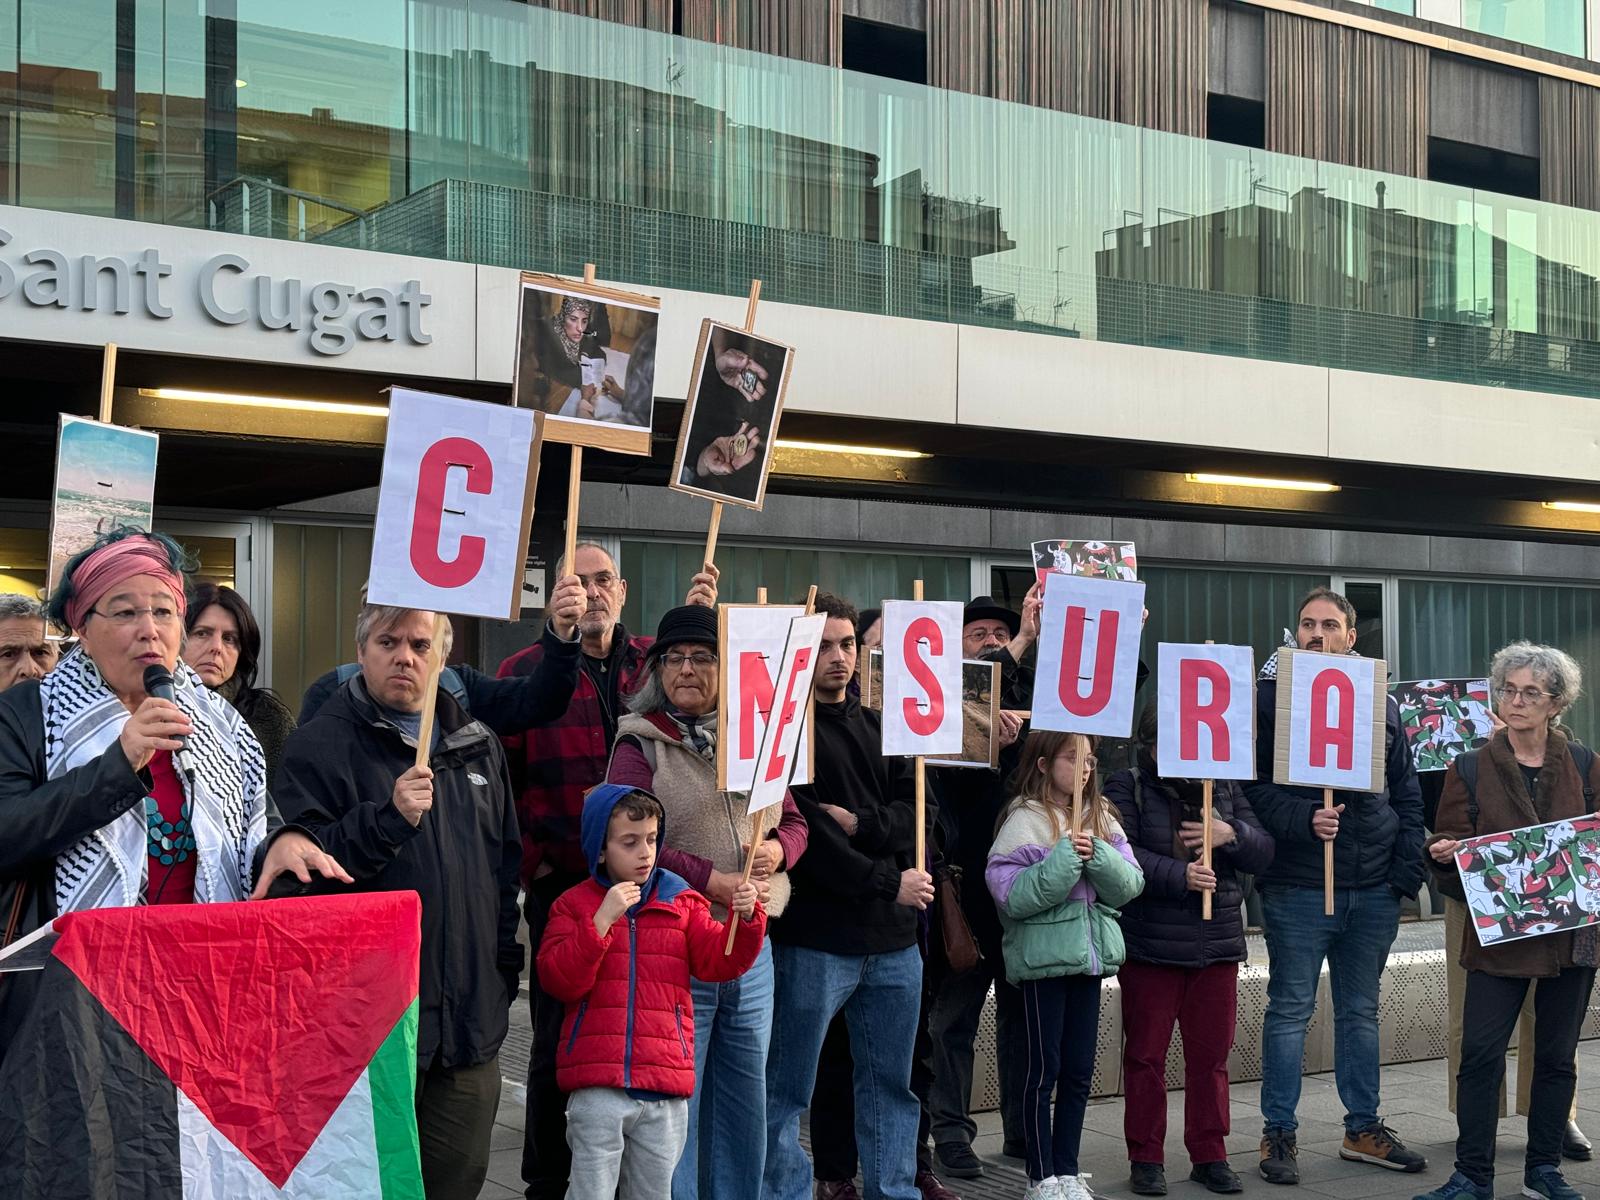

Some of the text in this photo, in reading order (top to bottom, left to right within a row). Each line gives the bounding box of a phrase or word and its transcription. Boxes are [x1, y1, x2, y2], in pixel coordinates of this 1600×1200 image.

[199, 253, 432, 355] Cugat
[411, 437, 492, 588] C
[765, 647, 812, 783] E
[903, 617, 944, 736] S
[1059, 606, 1120, 717] U
[1180, 659, 1231, 762] R
[1309, 668, 1355, 771] A
